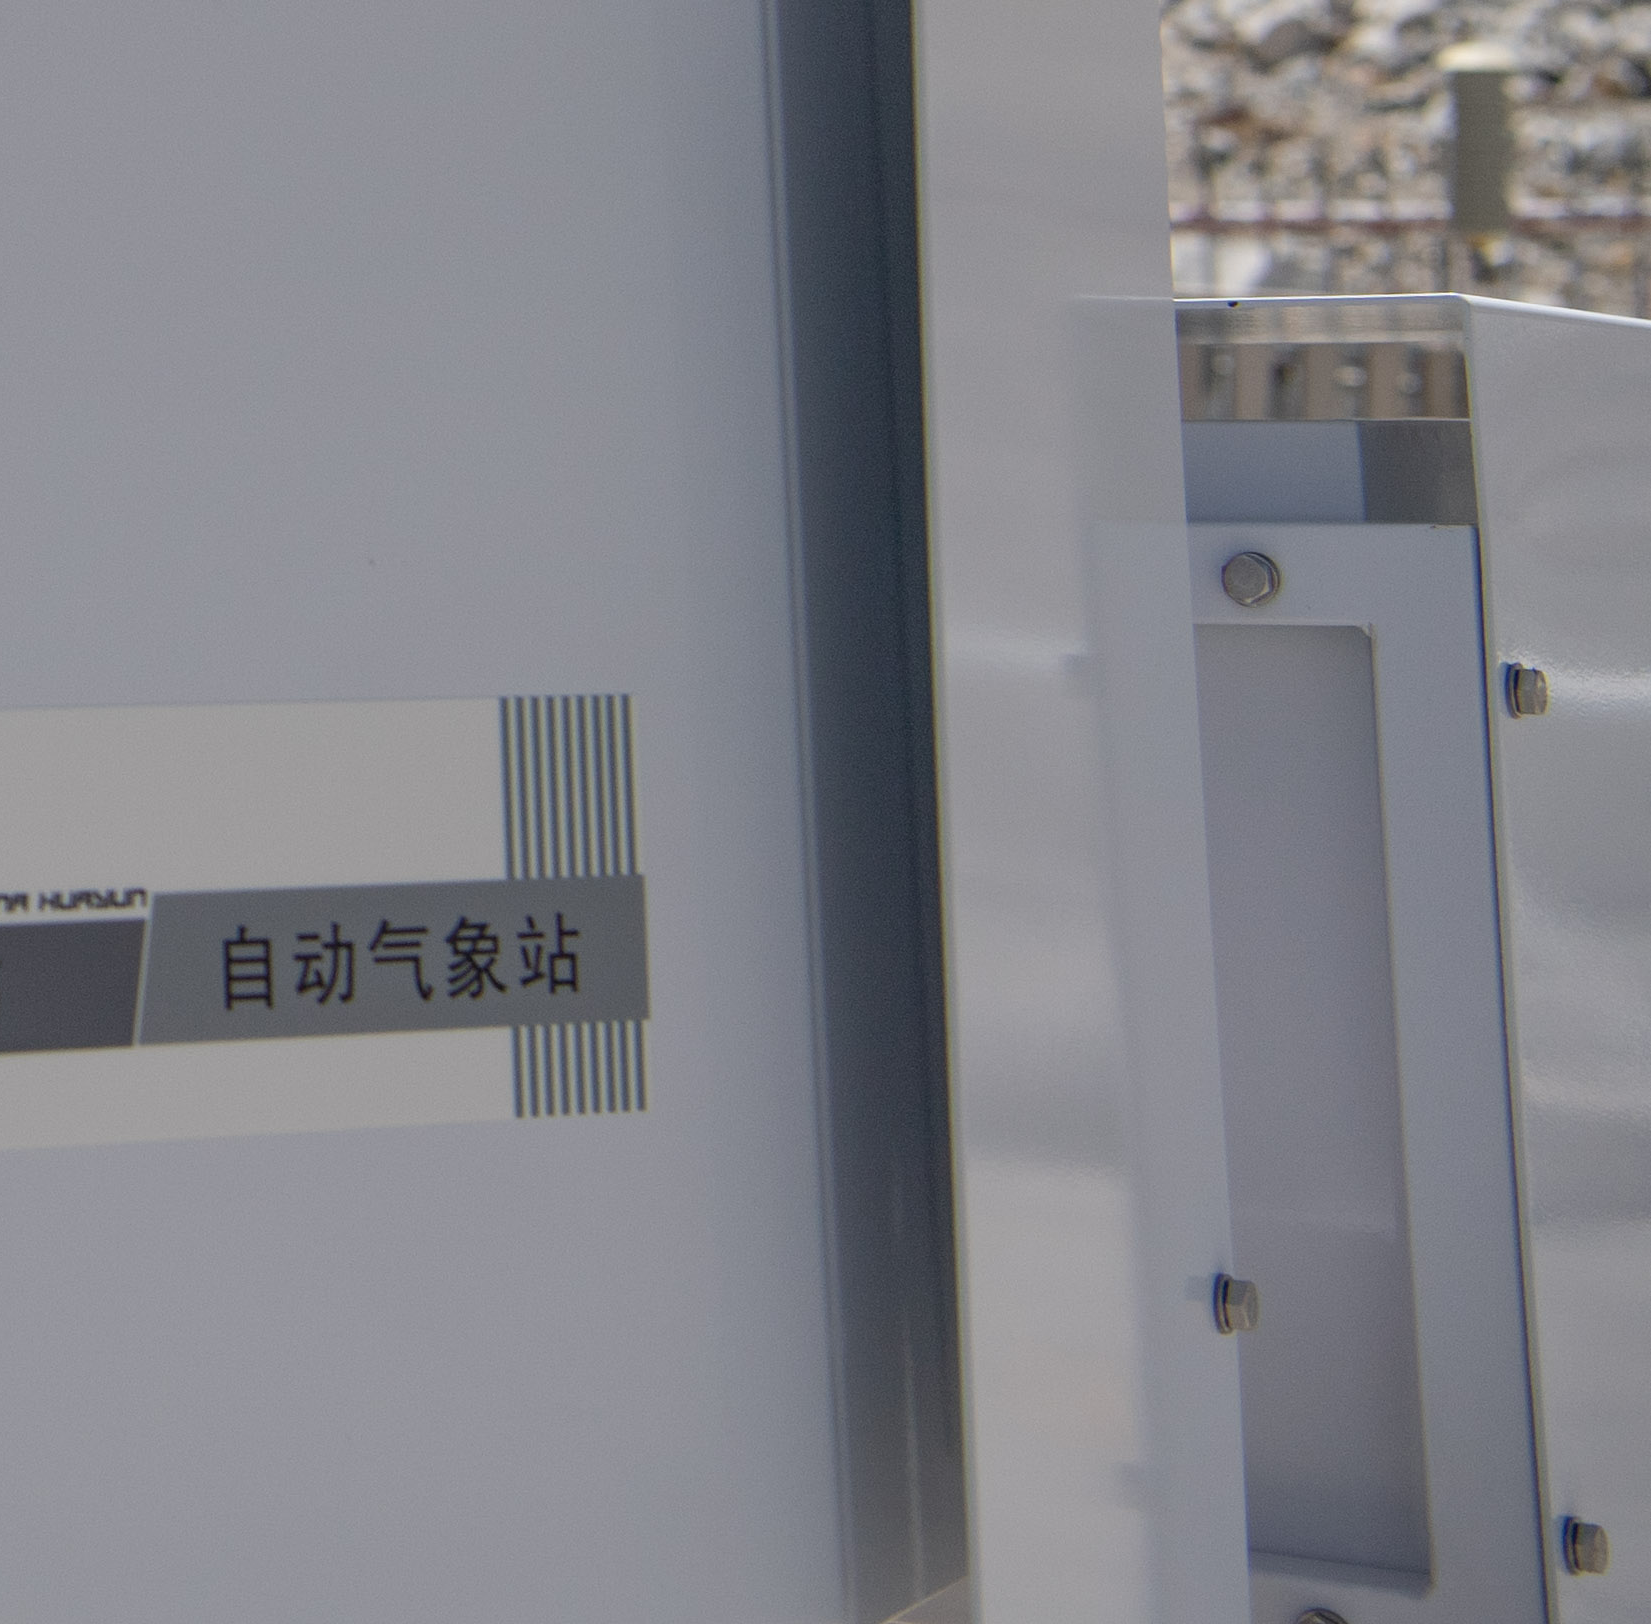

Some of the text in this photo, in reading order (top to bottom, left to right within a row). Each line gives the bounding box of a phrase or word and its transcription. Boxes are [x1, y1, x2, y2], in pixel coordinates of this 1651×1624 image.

[220, 913, 583, 1012] 自动气象站
